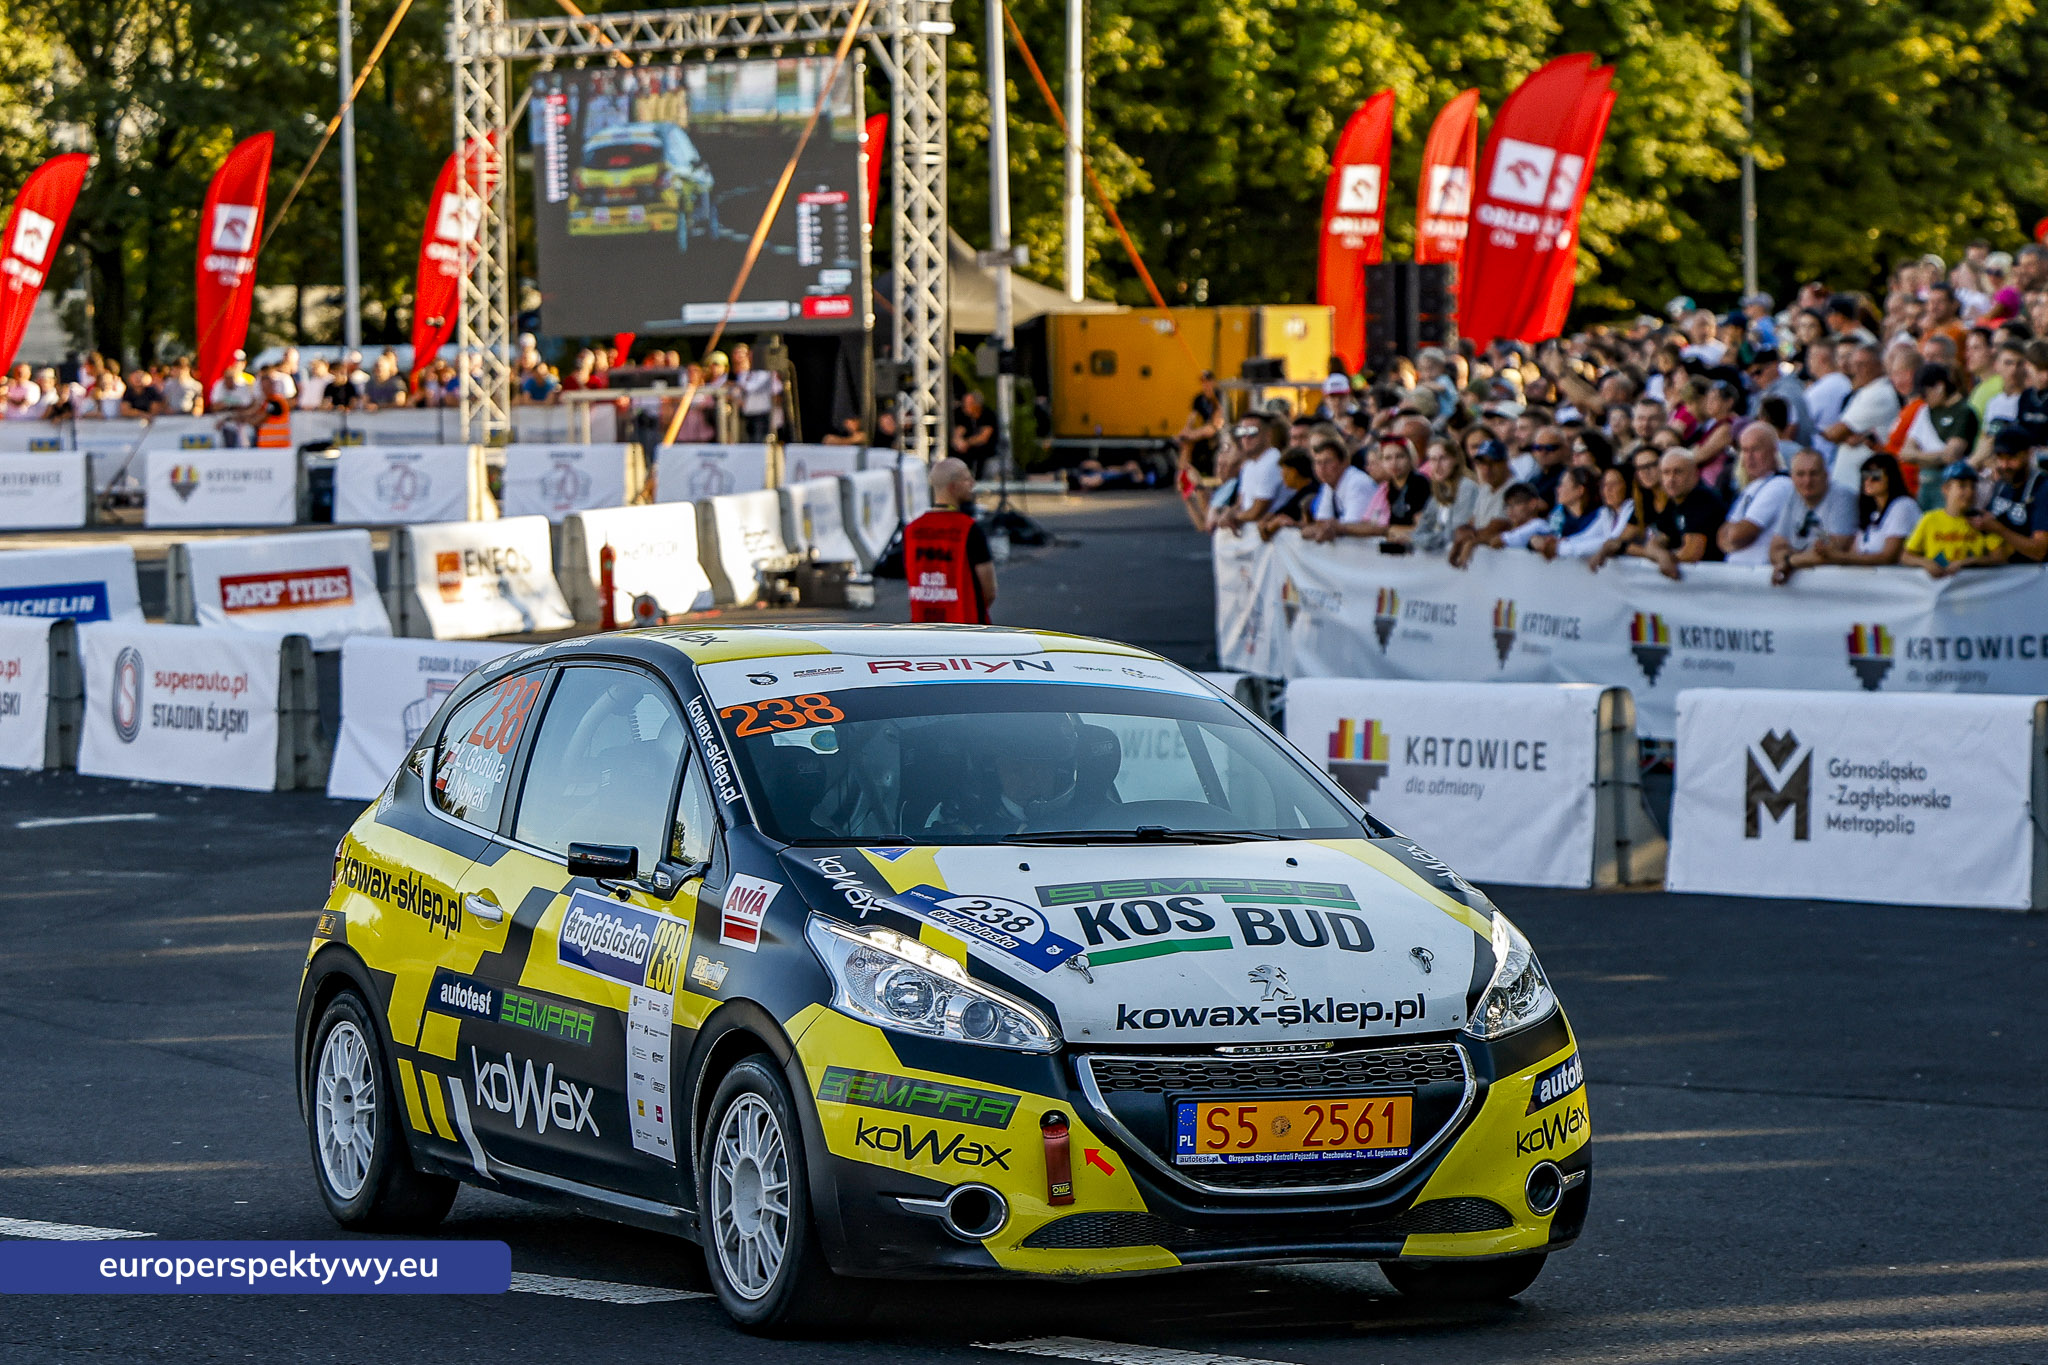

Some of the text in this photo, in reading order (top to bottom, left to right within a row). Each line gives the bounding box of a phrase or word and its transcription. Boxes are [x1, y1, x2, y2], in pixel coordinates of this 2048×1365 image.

[224, 576, 349, 608] MRF TYRES
[1522, 612, 1580, 640] KATOWICE
[1680, 625, 1775, 654] KATOWICE
[1906, 634, 2048, 662] KATOWICE
[867, 659, 1055, 674] RallyN
[154, 670, 249, 699] superauto.pl
[152, 701, 249, 741] STADION ŚLĄSKI
[467, 675, 541, 754] 238
[720, 694, 845, 738] 238
[686, 695, 742, 805] kowax-sklep.pl
[1405, 735, 1548, 771] KATOWICE
[1828, 758, 1927, 784] Górnośląsko
[1428, 777, 1485, 801] odmiany
[1826, 812, 1915, 837] Metropolia
[341, 843, 463, 940] kowax-sklep.pl
[813, 855, 882, 918] koWax
[1048, 880, 1344, 902] SEMPRA
[930, 909, 1017, 948] #rajdslaska
[956, 900, 1035, 932] 238
[1074, 897, 1375, 952] KOS BUD
[565, 908, 687, 994] #rajdslaska 238
[440, 982, 491, 1015] autotest
[1116, 993, 1426, 1030] kowax-sklep.pl
[500, 991, 595, 1043] SEMPRA
[1243, 1044, 1318, 1053] PEUGEOT
[471, 1045, 600, 1137] koWax
[820, 1072, 1013, 1125] SEMPRA
[1179, 1135, 1194, 1147] PL
[1206, 1101, 1394, 1149] S5 2561
[1517, 1102, 1587, 1158] koWax
[855, 1117, 1012, 1171] koWax
[1179, 1154, 1219, 1165] autotest.pl
[1255, 1152, 1272, 1162] Stacja
[1398, 1148, 1409, 1157] 243
[1052, 1184, 1070, 1195] OMP
